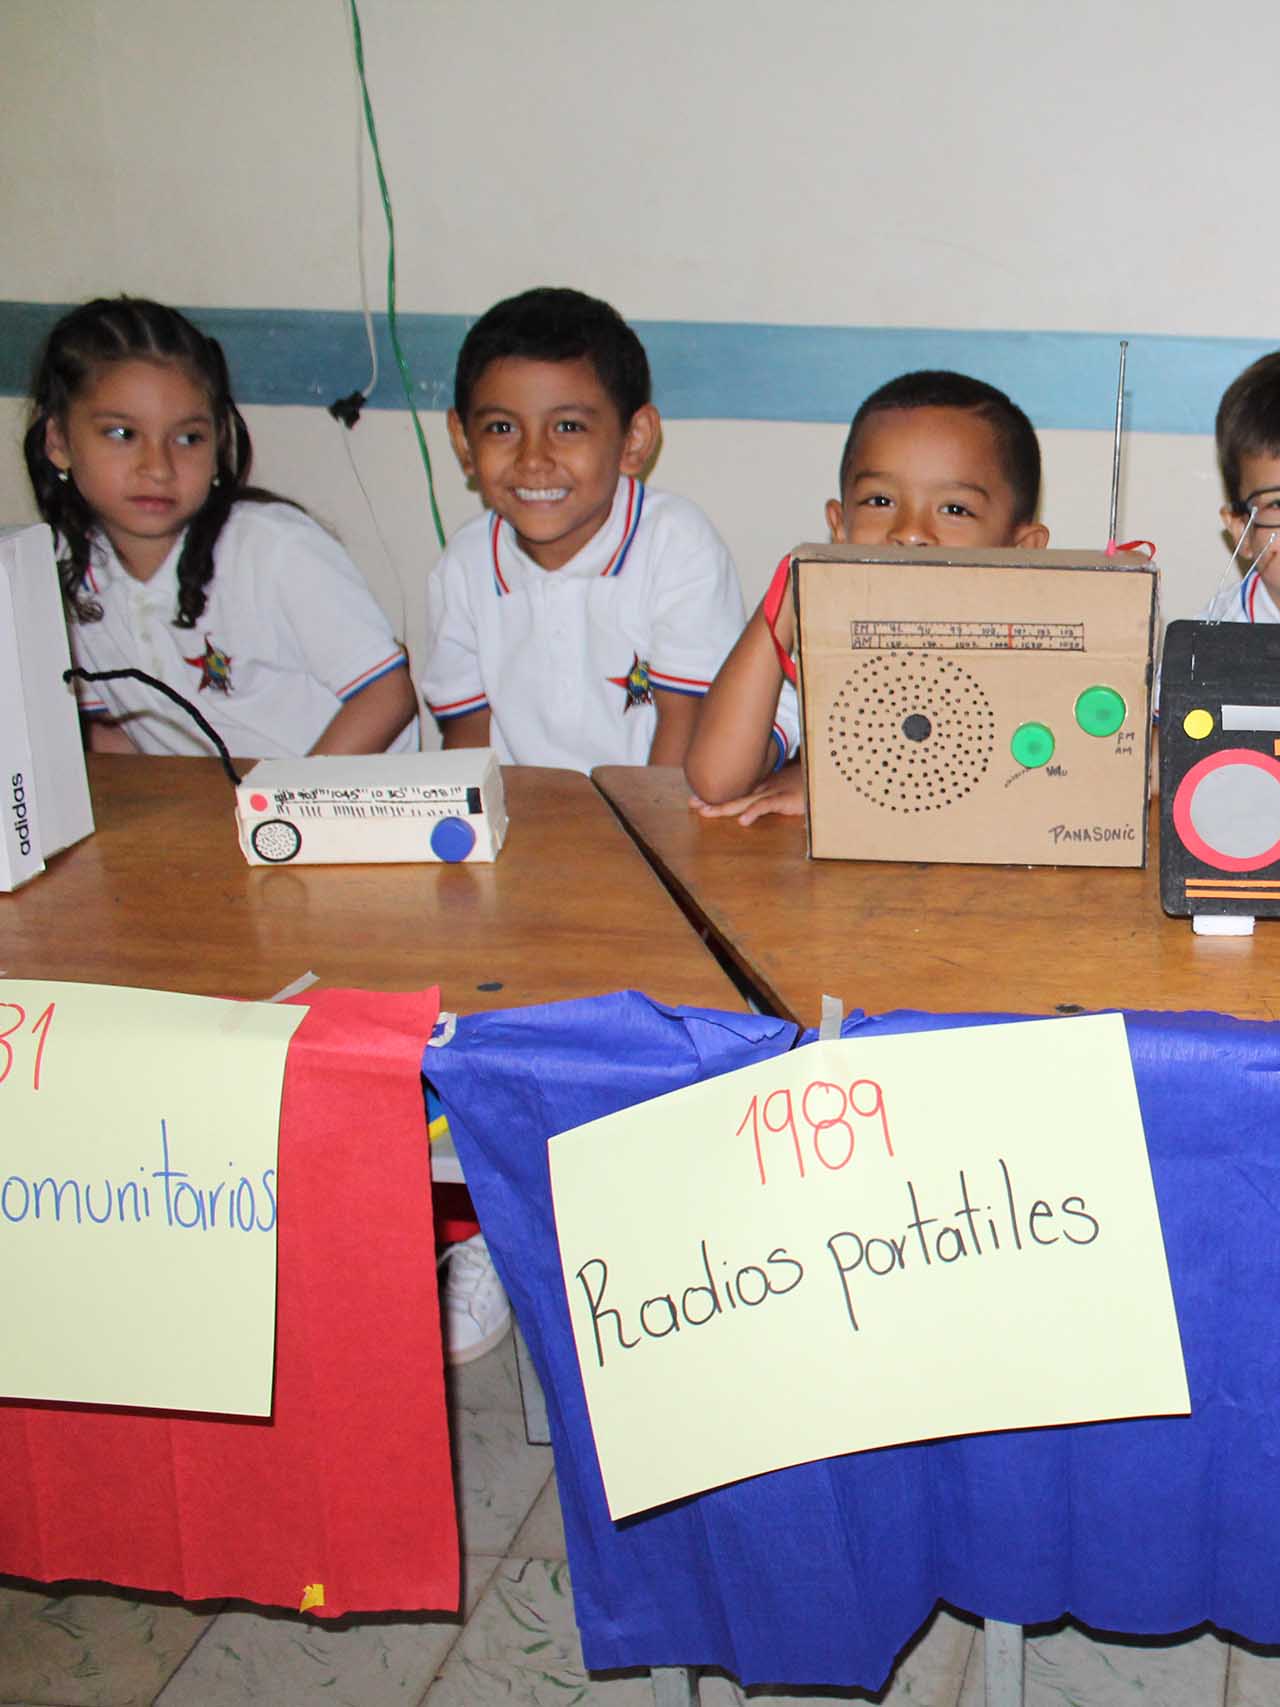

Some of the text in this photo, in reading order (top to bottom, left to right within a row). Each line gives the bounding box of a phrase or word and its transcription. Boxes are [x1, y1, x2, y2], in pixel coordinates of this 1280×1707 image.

[1114, 746, 1133, 756] AM
[1117, 731, 1136, 744] FM
[12, 772, 31, 856] adidas
[1047, 823, 1136, 845] PANASONiC
[736, 1079, 894, 1185] 1989
[1, 1118, 277, 1232] omunitarios
[575, 1158, 1100, 1367] Radios portatiles
